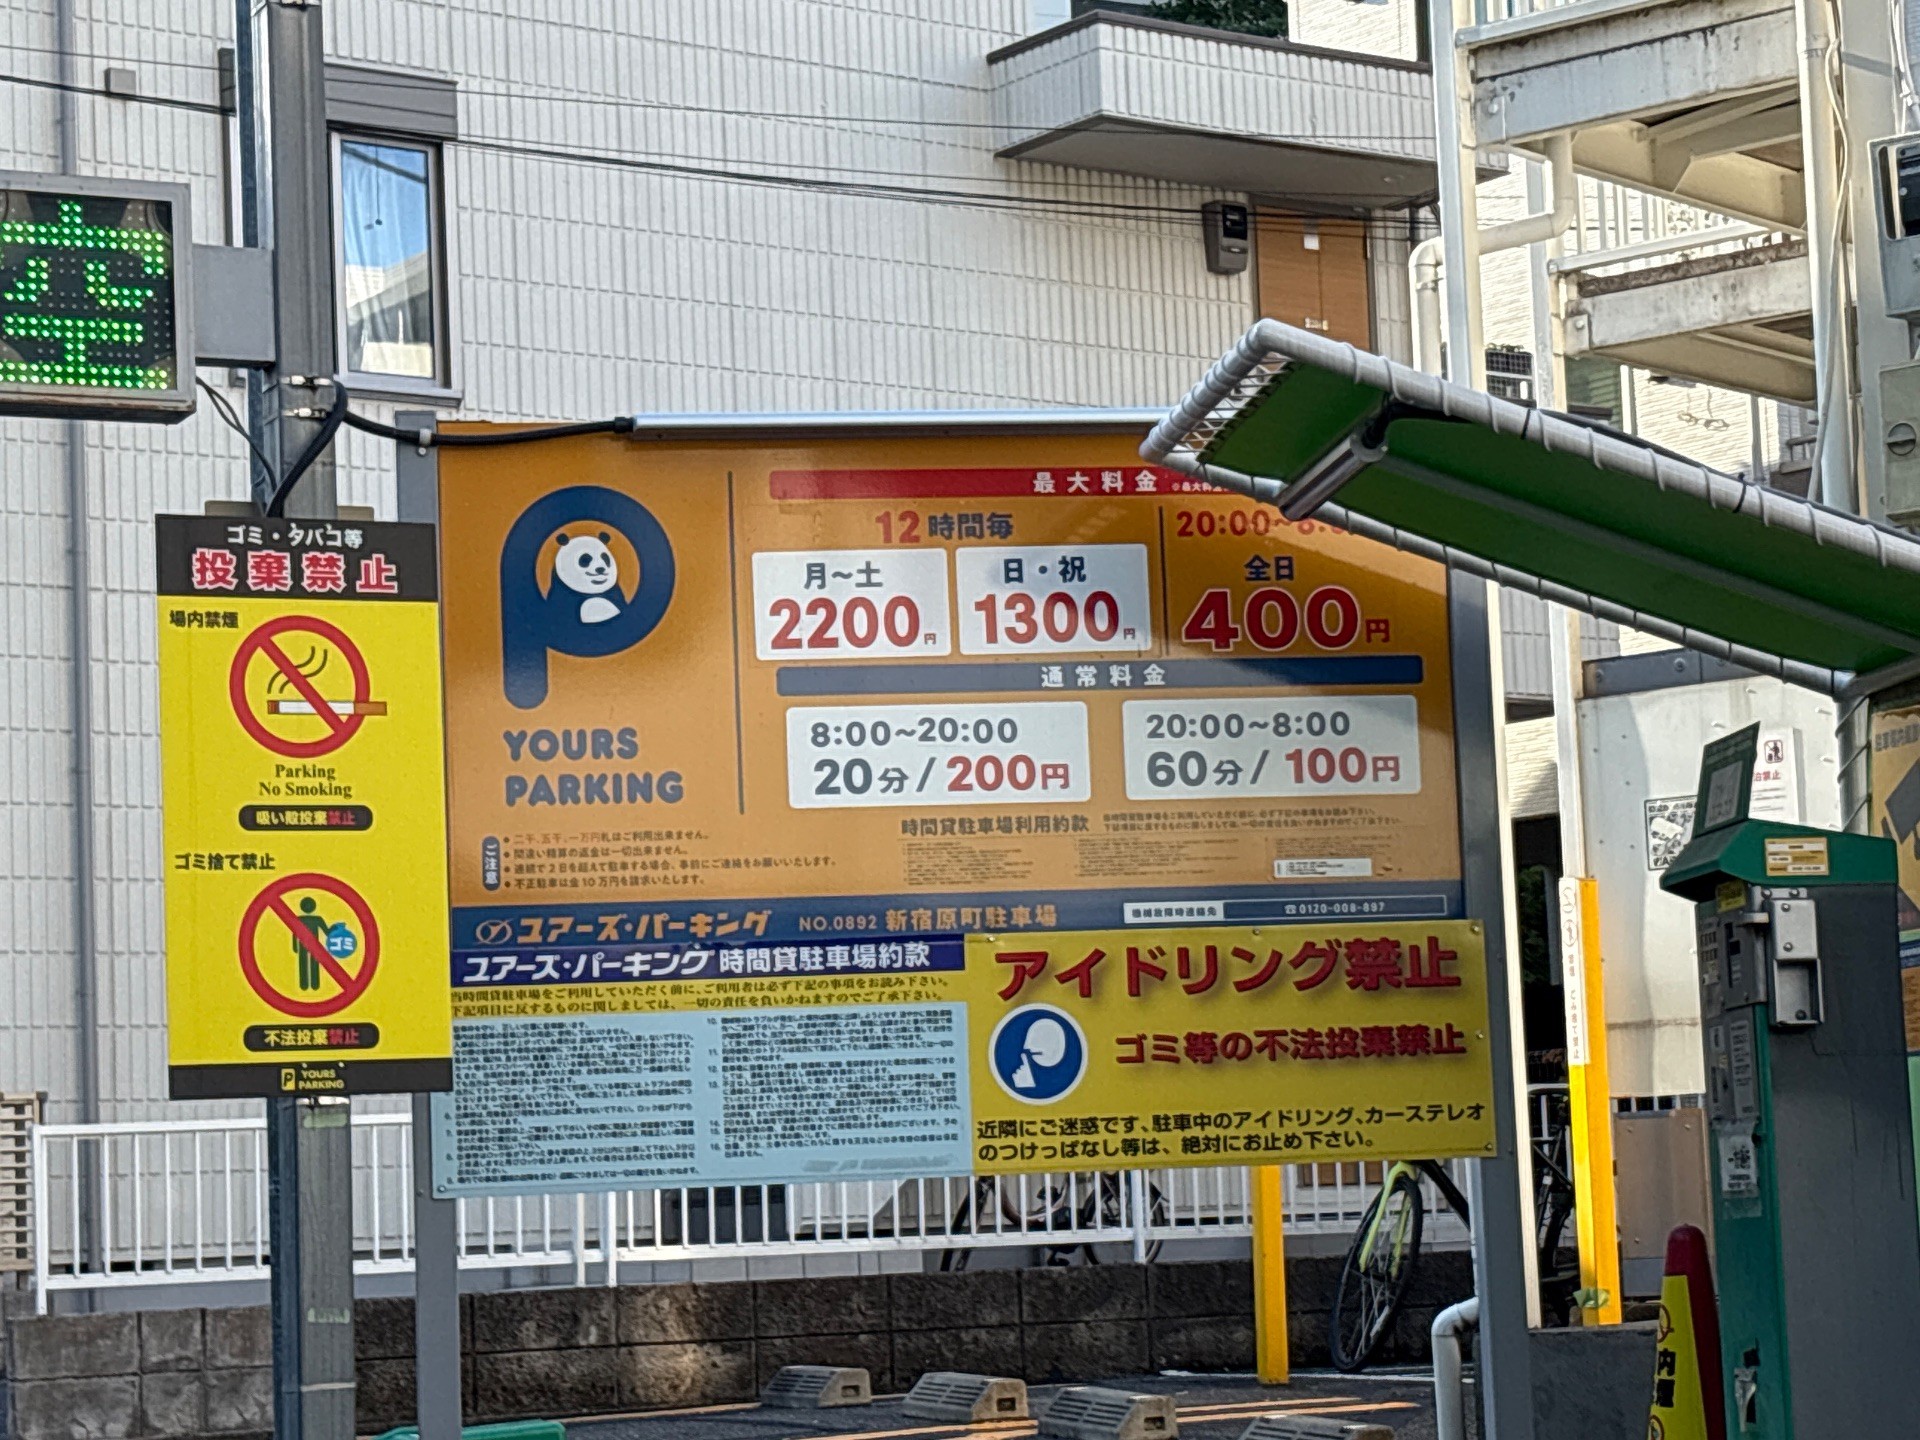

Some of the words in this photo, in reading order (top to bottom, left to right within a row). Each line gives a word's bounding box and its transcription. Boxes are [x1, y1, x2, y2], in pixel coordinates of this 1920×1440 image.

[1033, 470, 1157, 494] 最大料金
[227, 523, 364, 549] ゴミ・タバコ等
[876, 510, 1013, 543] 12時間毎
[191, 548, 398, 593] 投棄禁止
[804, 561, 883, 589] 月～土
[1003, 555, 1086, 584] 日・祝
[1244, 555, 1294, 581] 全日
[170, 610, 239, 629] 場内禁煙
[769, 594, 936, 650] 2200円
[974, 590, 1135, 644] 1300円
[1182, 584, 1390, 652] 400円
[1041, 663, 1166, 688] 通常料金
[503, 727, 639, 762] YOURS
[274, 764, 336, 782] Parking
[259, 782, 280, 796] No
[285, 782, 352, 799] Smoking
[505, 771, 684, 807] PARKING
[901, 813, 1090, 837] 時間貸駐車場利用約款
[174, 852, 275, 871] ゴミ捨て禁止
[517, 908, 772, 944] ユアーズ・パーキング
[799, 914, 878, 931] NO.0892
[885, 903, 1057, 932] 新宿原町駐車場
[329, 937, 354, 951] ゴミ
[994, 936, 1462, 1001] アイドリング禁止
[264, 1028, 360, 1047] 不法投棄禁止
[1115, 1023, 1466, 1064] ゴミ等の不法投棄禁止
